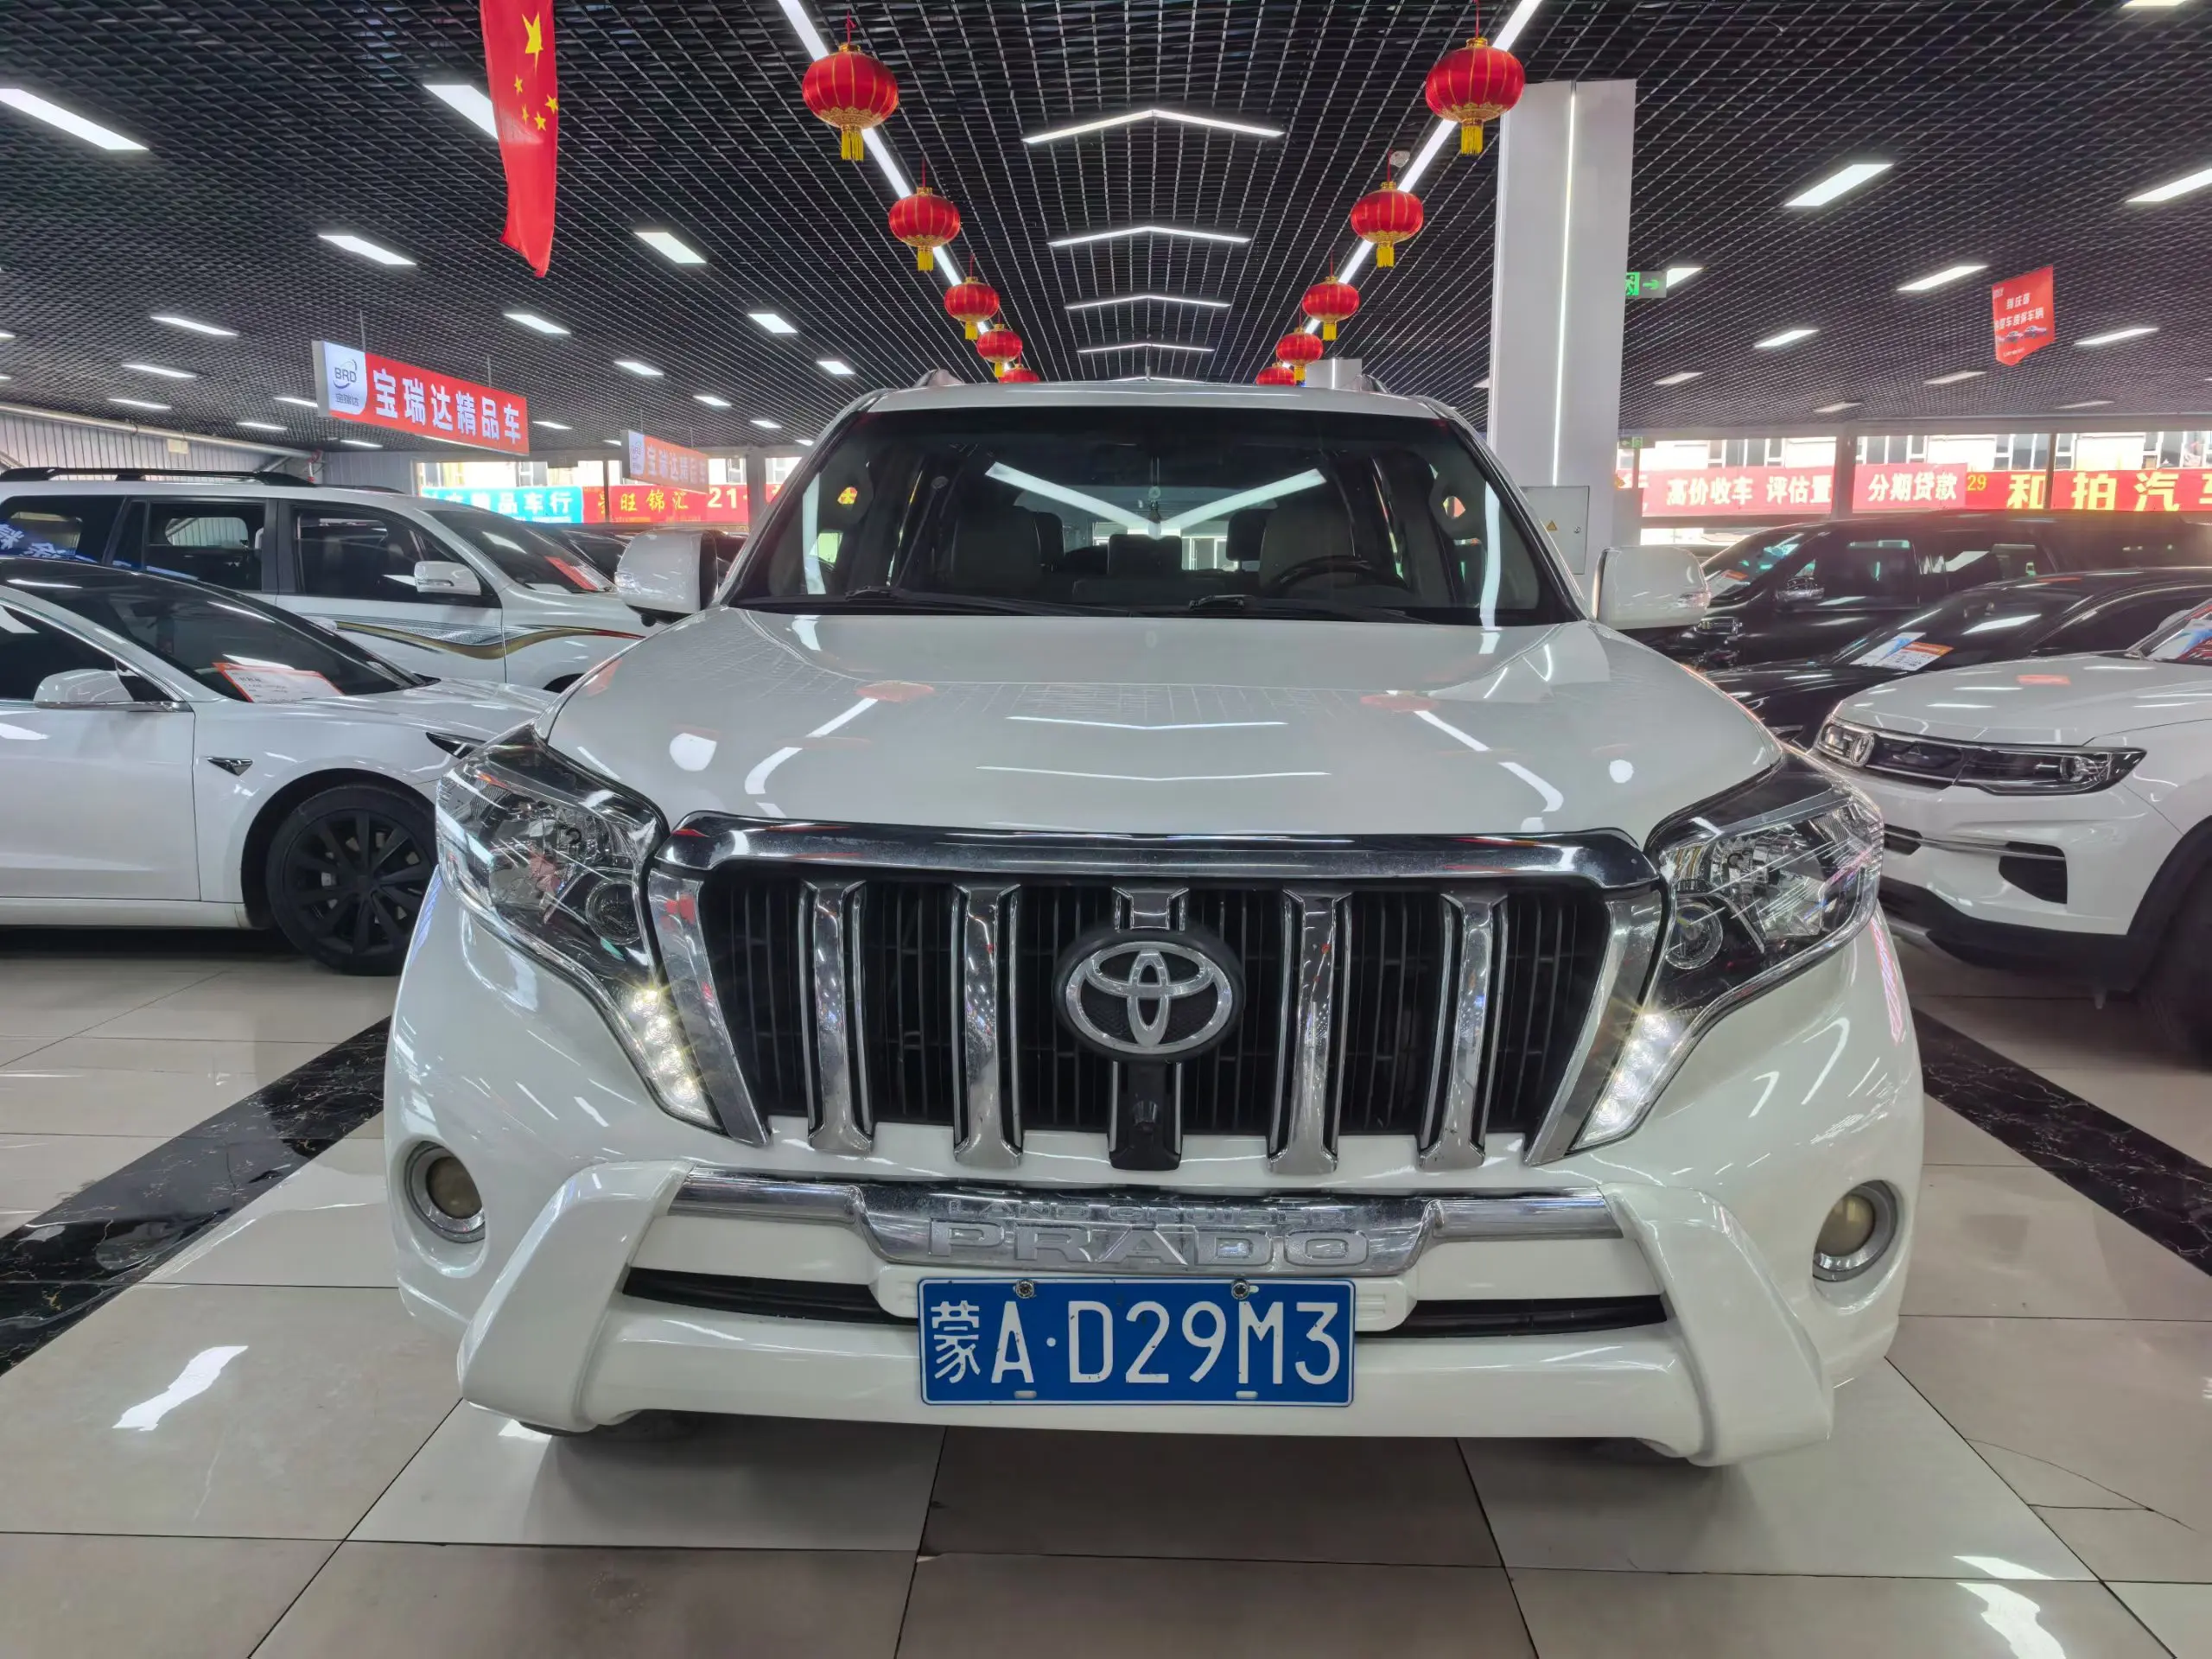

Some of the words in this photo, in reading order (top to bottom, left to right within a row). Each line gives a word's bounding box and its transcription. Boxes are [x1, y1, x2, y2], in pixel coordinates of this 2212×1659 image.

[334, 367, 357, 384] BRD
[335, 393, 359, 407] 宝瑞达
[372, 368, 521, 444] 宝瑞达精品车
[1667, 475, 1753, 505] 高价收车
[1867, 471, 1958, 502] 分期贷款
[1967, 474, 1986, 491] 29
[928, 1217, 1370, 1267] PRADO
[930, 1300, 1340, 1385] 蒙A·D29M3
